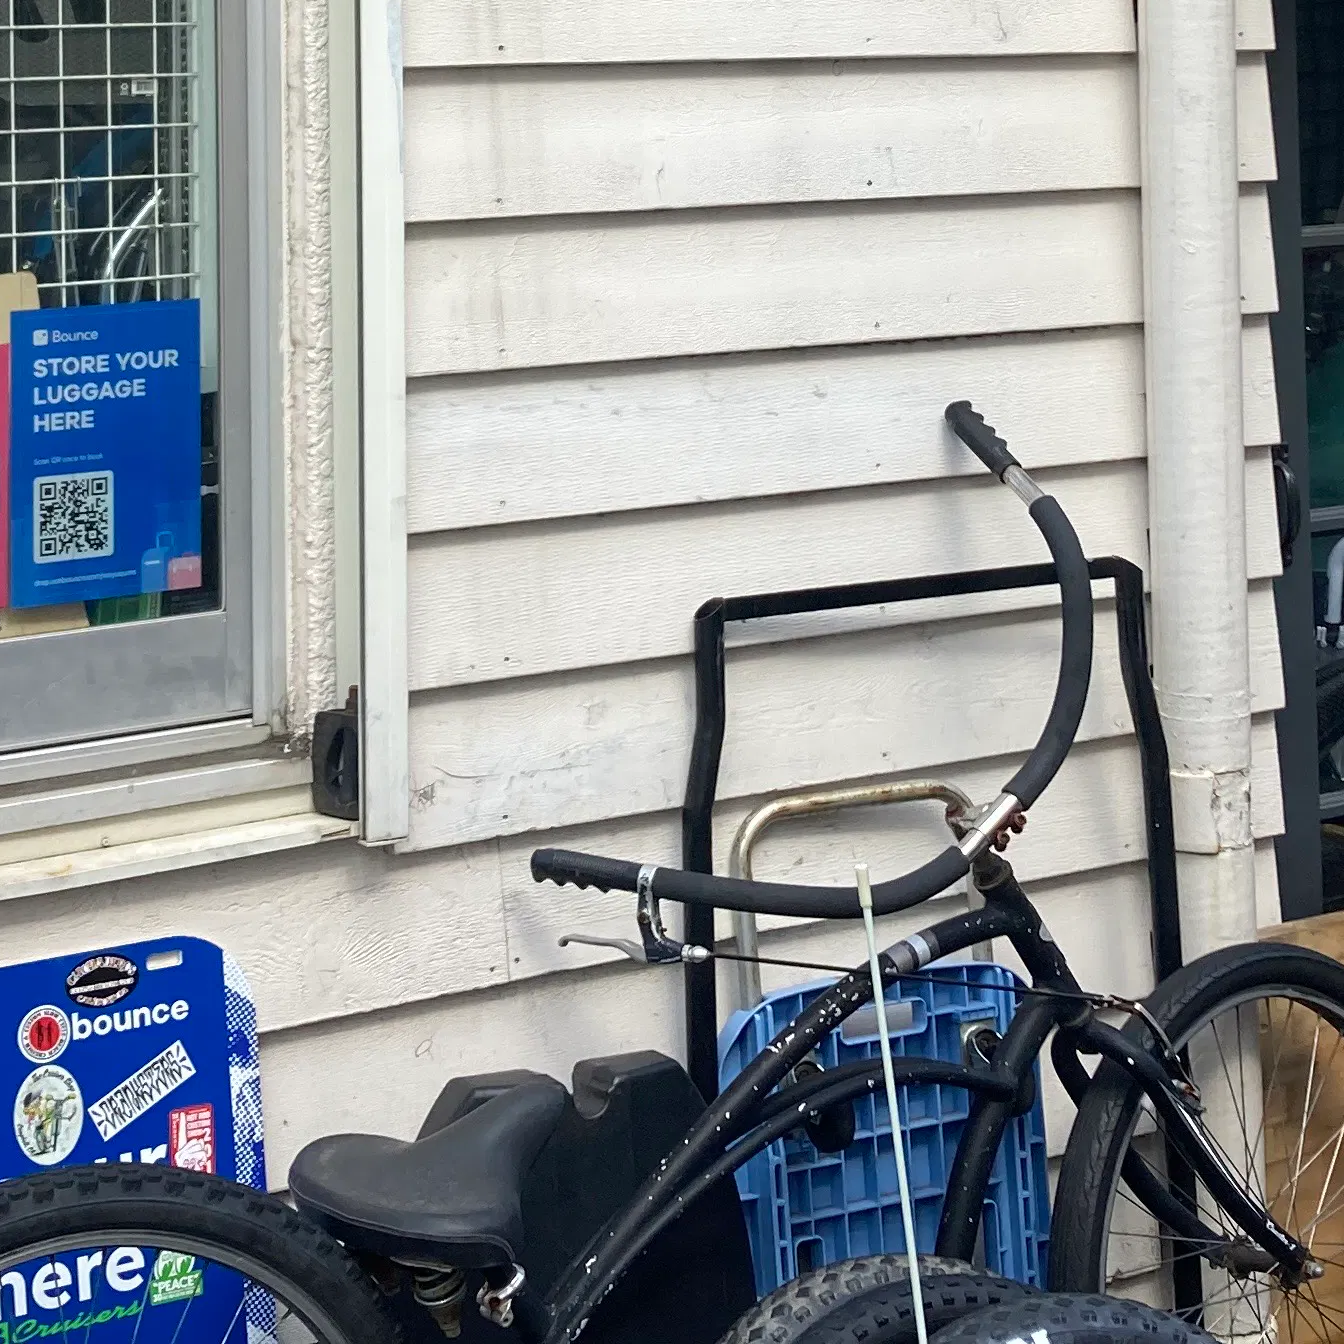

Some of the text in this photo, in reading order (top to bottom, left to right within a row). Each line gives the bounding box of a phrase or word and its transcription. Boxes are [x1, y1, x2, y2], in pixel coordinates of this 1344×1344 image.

[52, 330, 99, 343] Bounce
[33, 349, 179, 378] STORE YOUR
[33, 378, 146, 405] LUGGAGE
[33, 410, 95, 433] HERE
[71, 1000, 189, 1040] bounce
